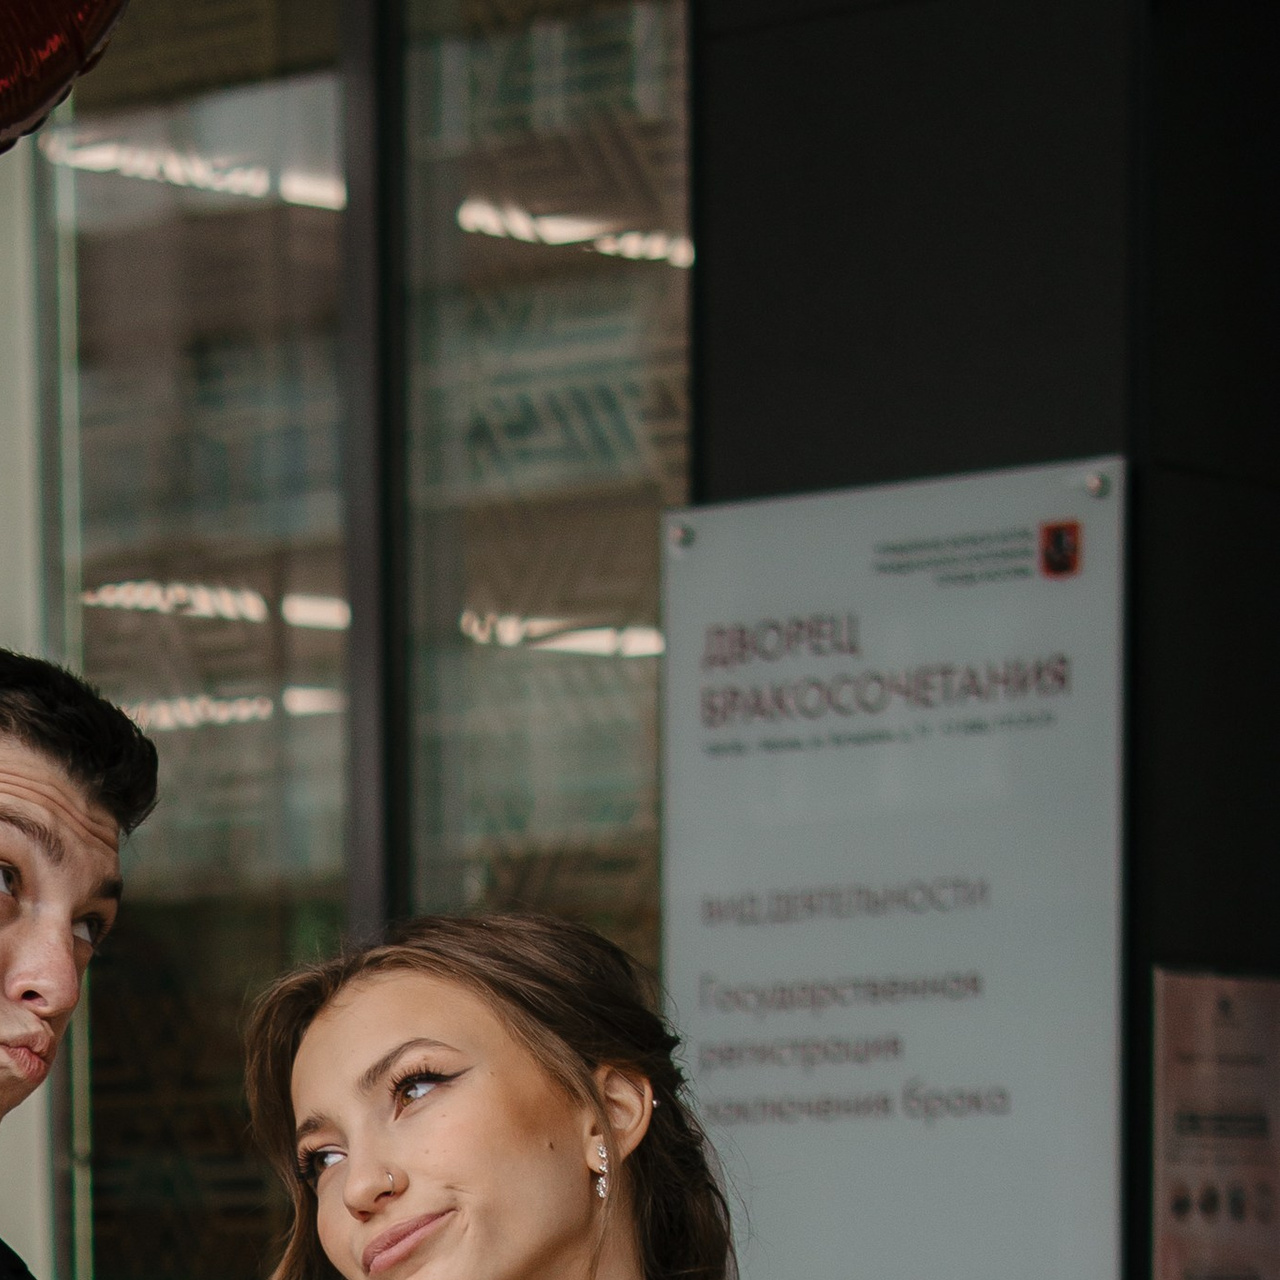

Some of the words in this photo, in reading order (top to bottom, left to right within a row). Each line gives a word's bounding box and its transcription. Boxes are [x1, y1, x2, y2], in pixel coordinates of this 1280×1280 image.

[702, 612, 860, 671] ДВОРЕЦ
[701, 654, 1071, 729] БРАКОСОЧЕТАНИЯ
[699, 970, 984, 1020] Государственная
